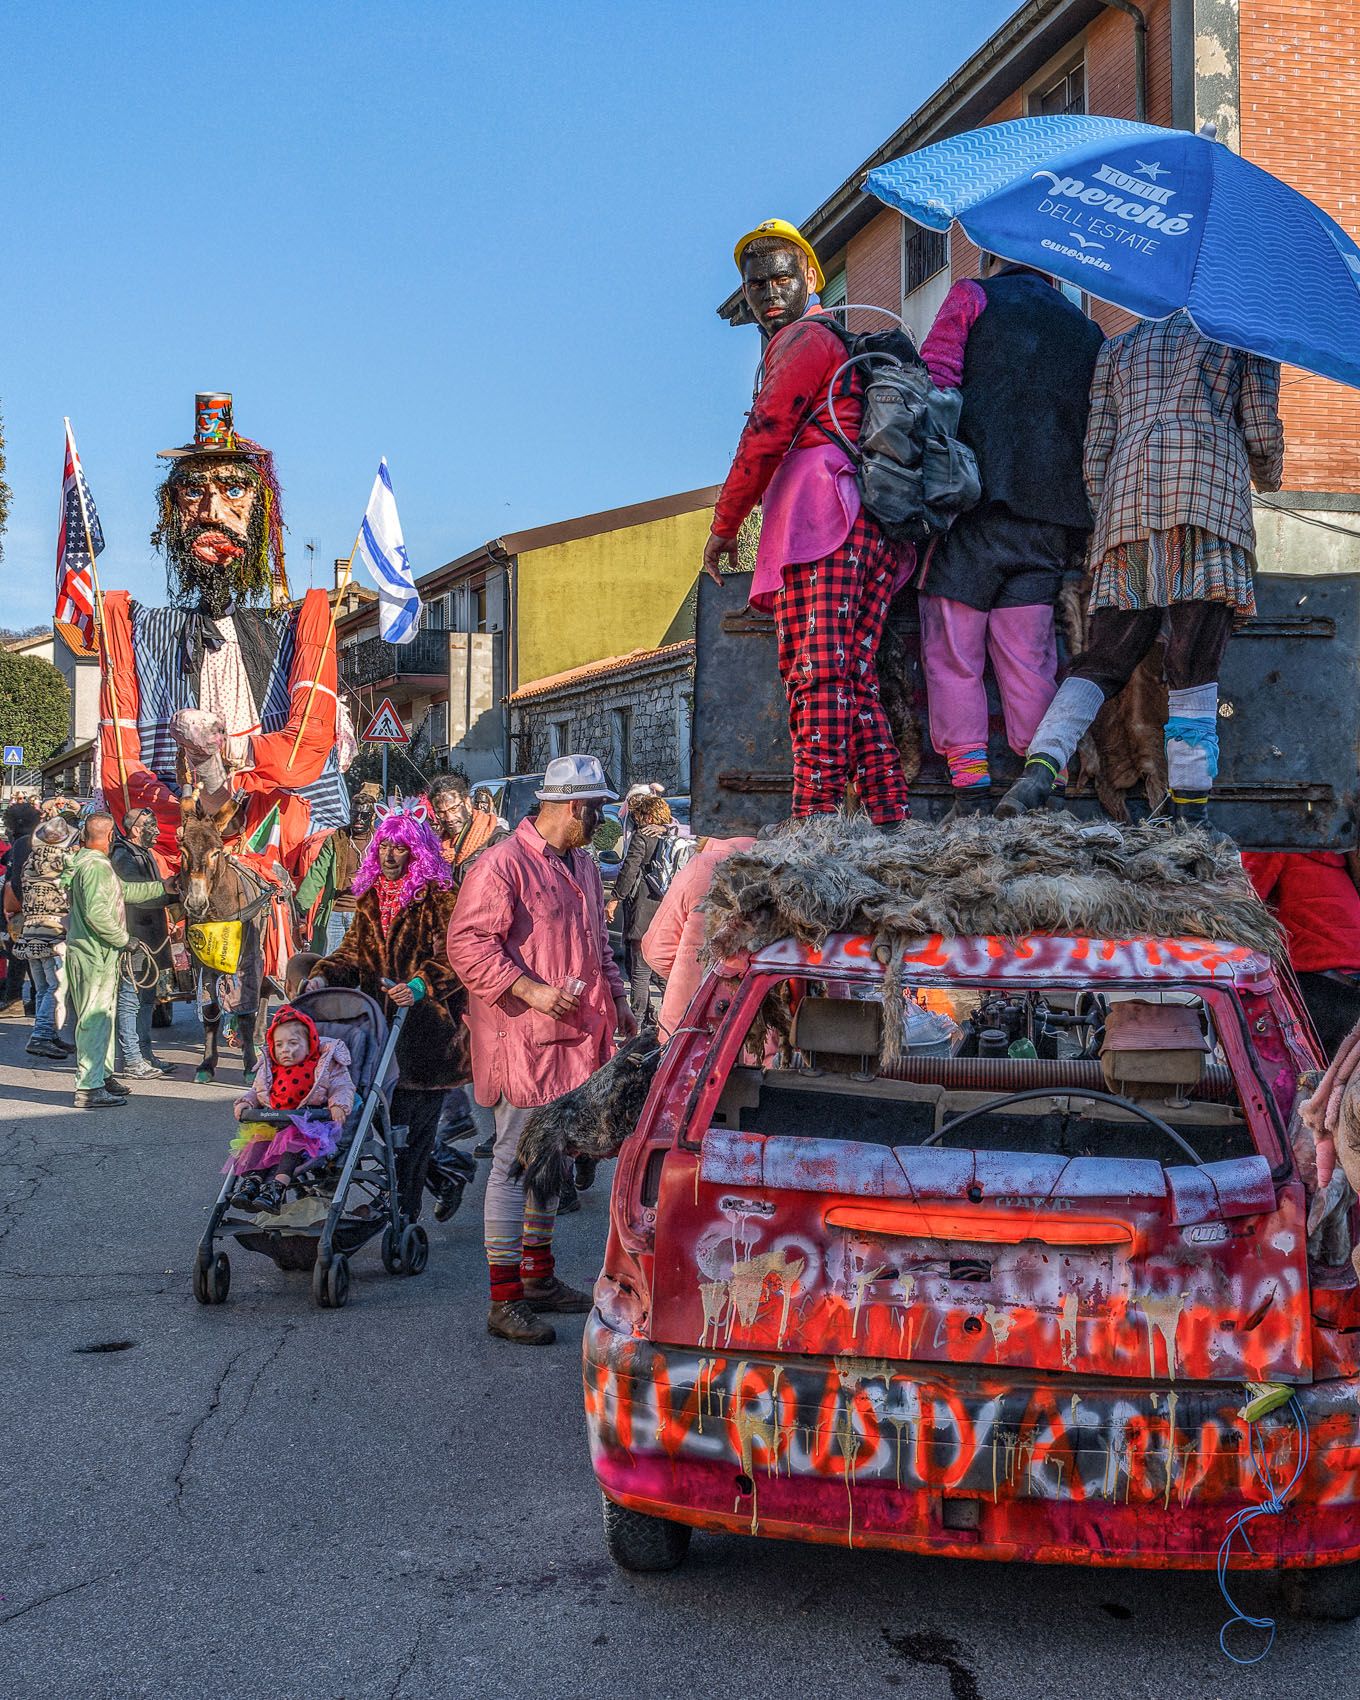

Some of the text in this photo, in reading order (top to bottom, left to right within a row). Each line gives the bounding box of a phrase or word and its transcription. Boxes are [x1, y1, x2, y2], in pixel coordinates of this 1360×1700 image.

[1031, 170, 1194, 236] perché
[1105, 168, 1156, 198] TUTTI
[1038, 198, 1161, 256] DELL'ESTATE
[1040, 238, 1113, 272] eurospin
